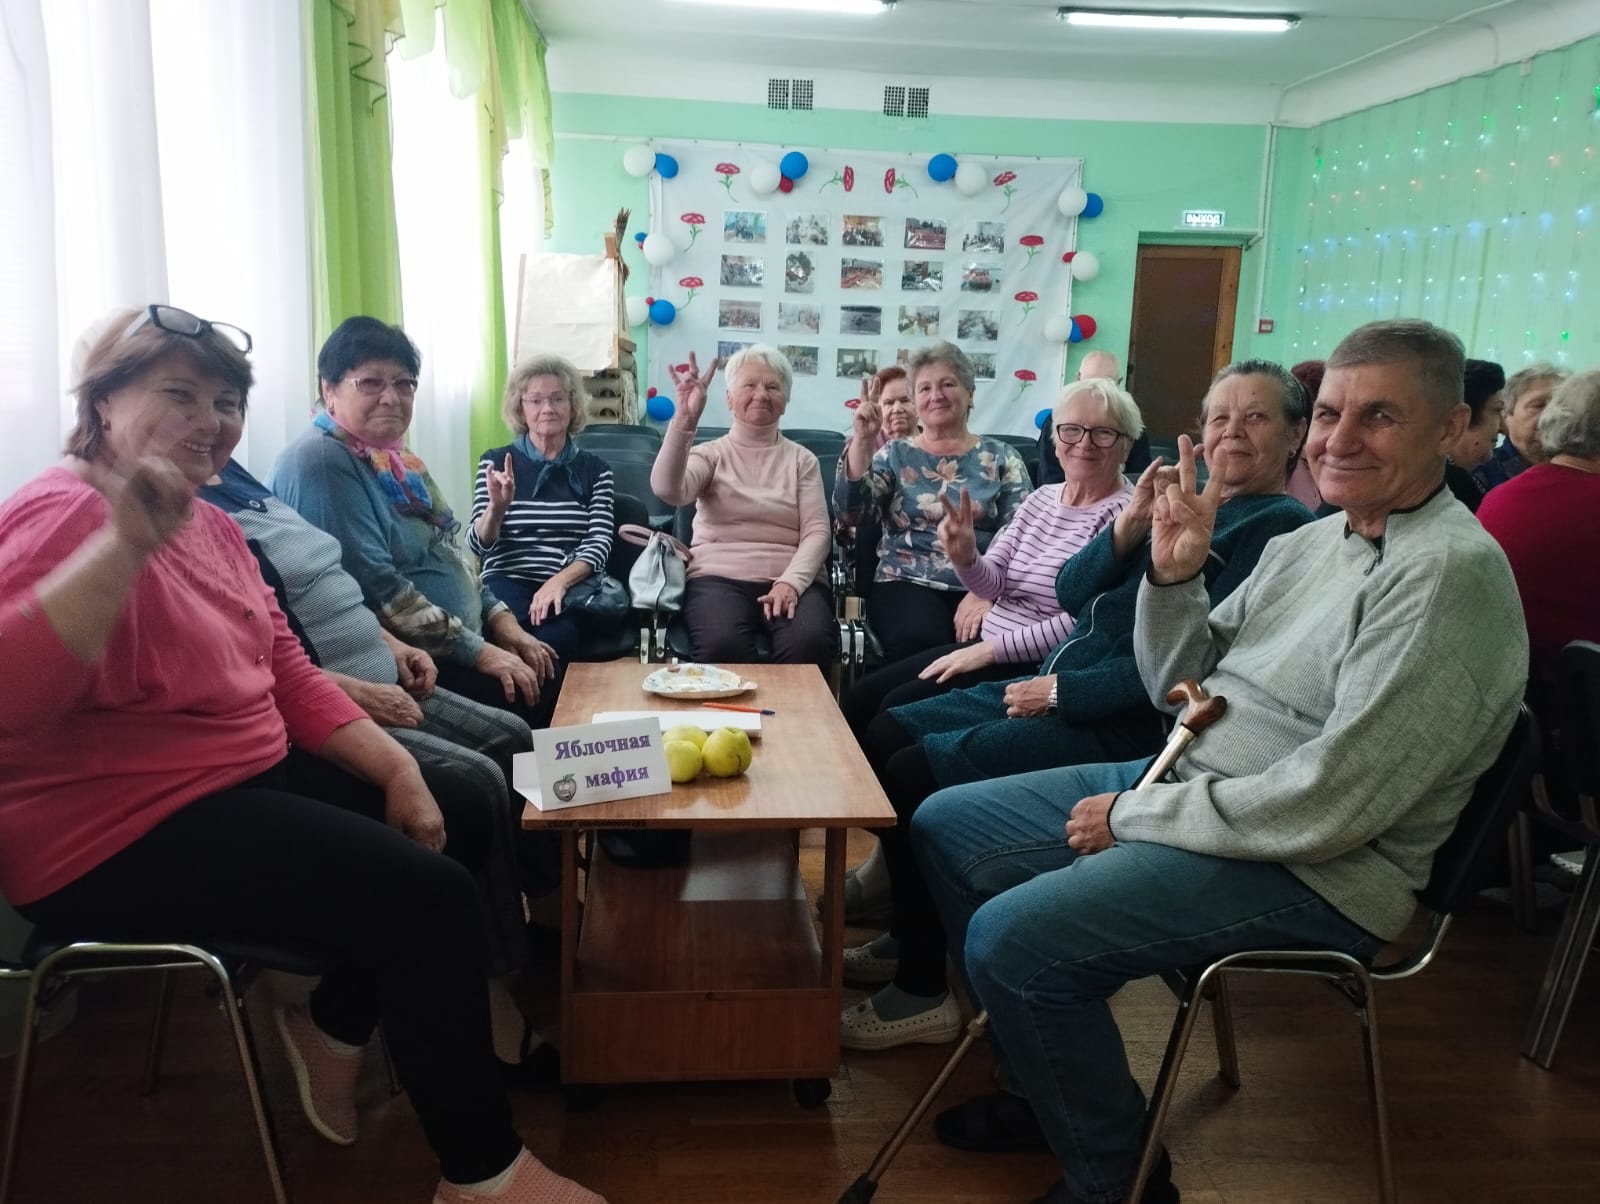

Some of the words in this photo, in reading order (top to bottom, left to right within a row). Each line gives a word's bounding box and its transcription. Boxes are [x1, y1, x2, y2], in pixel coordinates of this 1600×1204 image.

[1186, 213, 1220, 225] ВЫХОД
[555, 735, 651, 760] Яблочная
[585, 766, 649, 788] мафия
